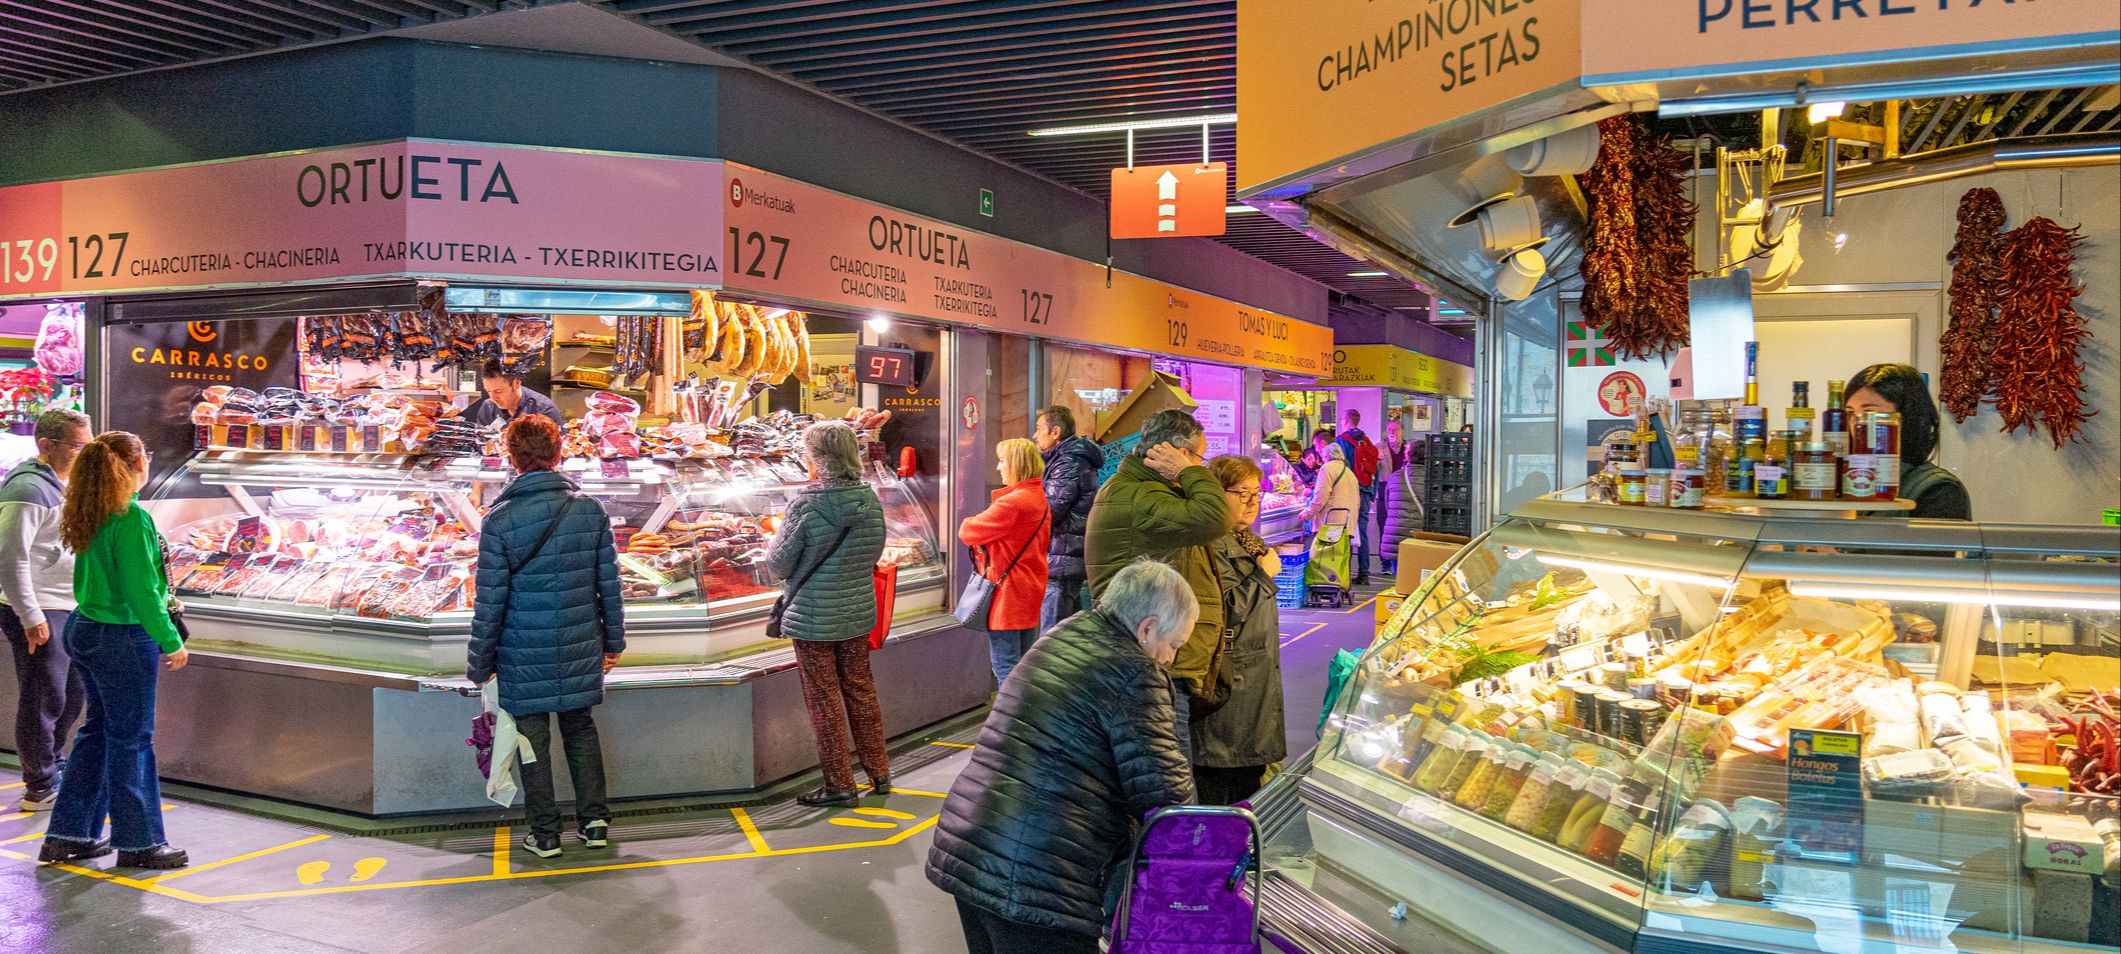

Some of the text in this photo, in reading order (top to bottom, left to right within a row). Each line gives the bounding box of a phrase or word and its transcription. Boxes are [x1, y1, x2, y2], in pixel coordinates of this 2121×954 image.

[1318, 0, 1540, 92] CHAMPIÑON
[1440, 16, 1541, 92] SETAS
[297, 154, 520, 208] ORTUETA
[744, 187, 796, 215] Merkatuak
[68, 232, 130, 279] 127
[363, 241, 517, 266] TXARKUTERIA
[538, 246, 719, 274] TXERRIKITEGIA
[729, 226, 791, 281] 127
[868, 215, 970, 271] ORTUETA
[0, 237, 58, 284] 139
[130, 253, 232, 277] CHARCUTERIA
[243, 247, 341, 270] CHACINERIA
[829, 255, 908, 285] CHARCUTERIA
[840, 277, 908, 304] CHACINERIA
[933, 275, 993, 301] TXARKUTERIA
[933, 294, 998, 319] TXERRIKITEGIA
[1021, 288, 1054, 326] 127
[1167, 319, 1188, 348] 129
[1238, 310, 1265, 337] TOMAS
[1272, 320, 1288, 342] LUCI
[131, 346, 268, 371] CARRASCO
[869, 356, 901, 379] 97
[170, 371, 231, 381] IBÉRICOS
[1328, 373, 1376, 382] ARAZKIAK
[884, 398, 941, 406] CARRASCO
[1791, 757, 1839, 772] Hongos
[1791, 769, 1836, 784] Boletus
